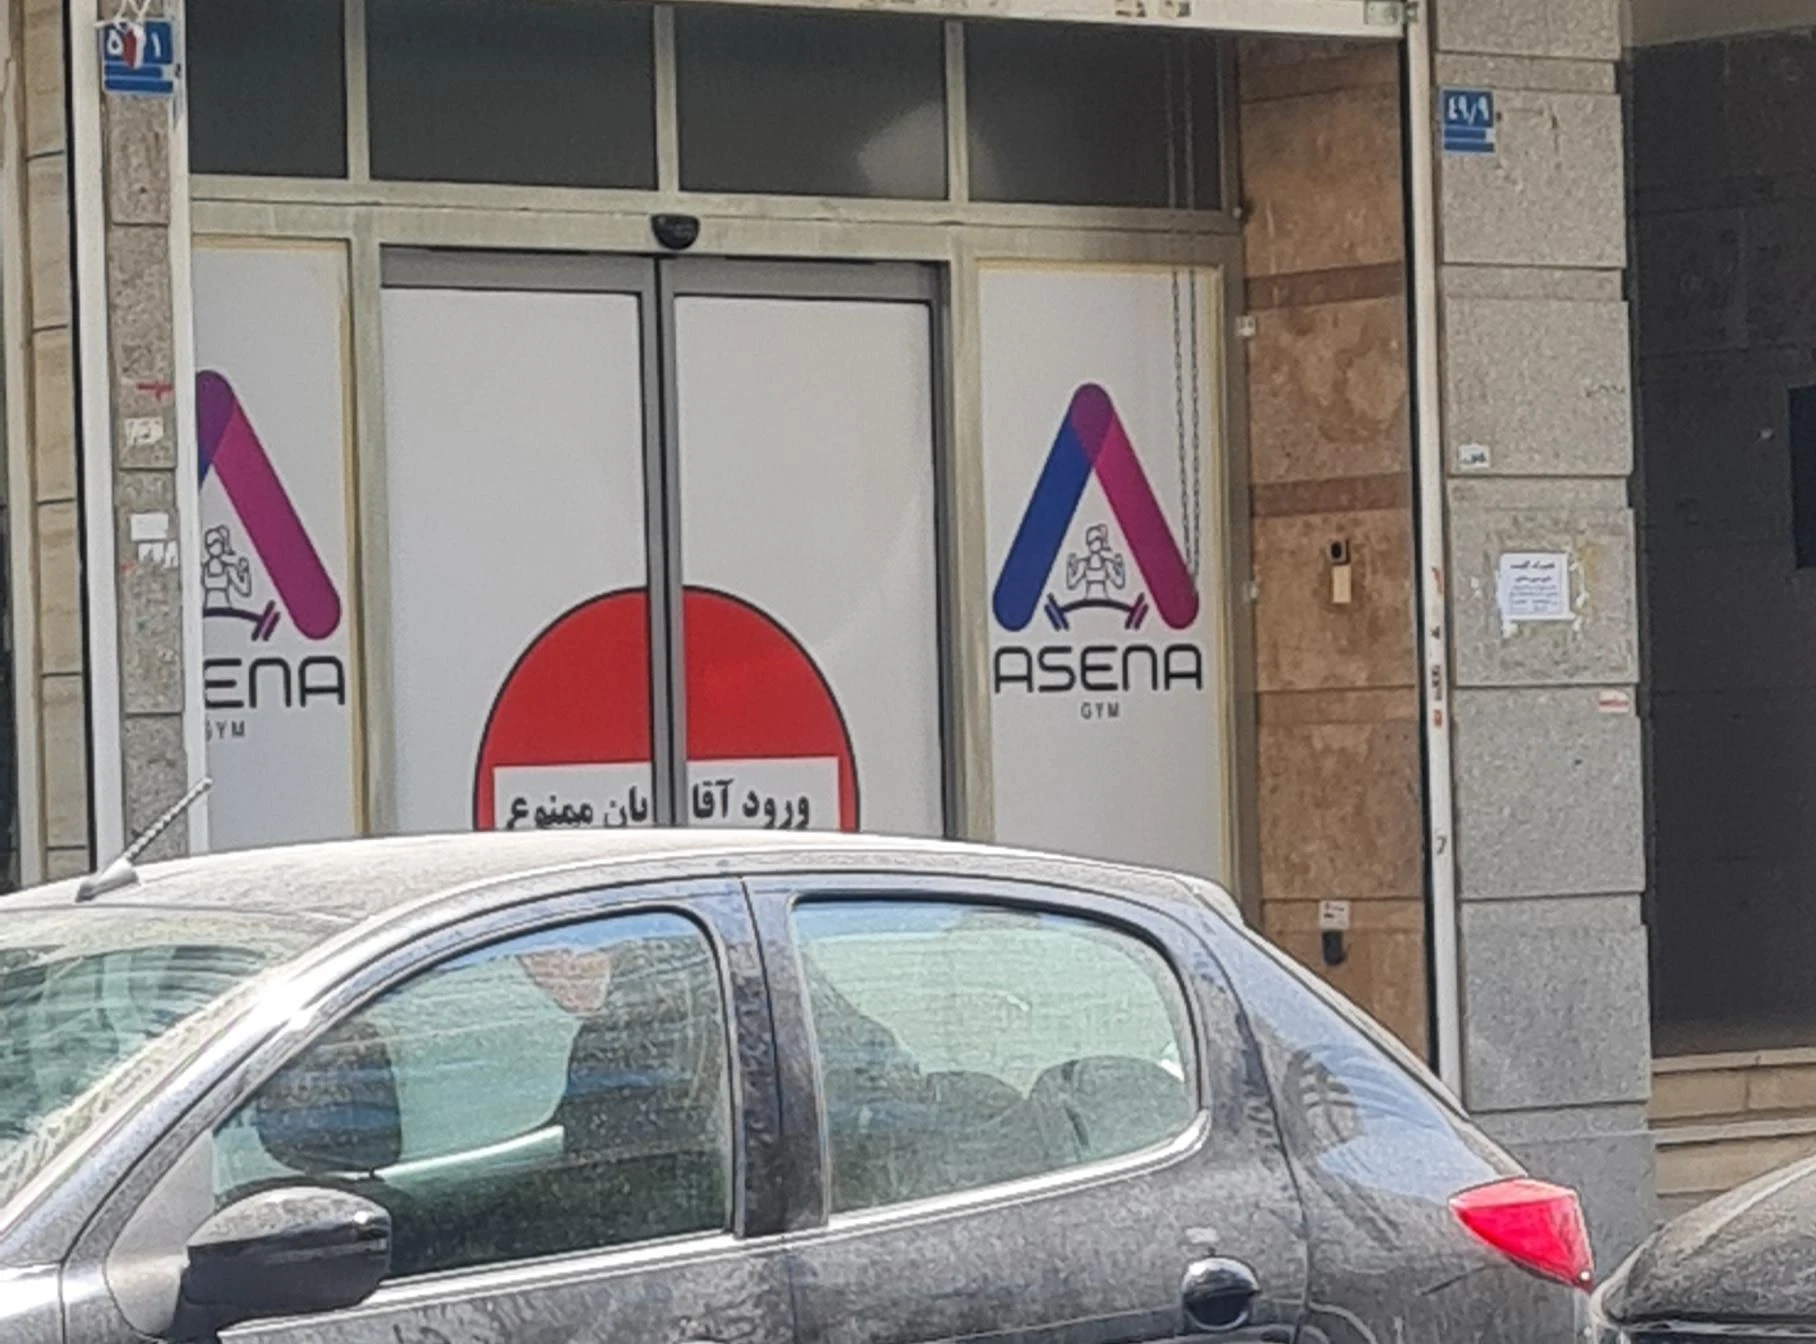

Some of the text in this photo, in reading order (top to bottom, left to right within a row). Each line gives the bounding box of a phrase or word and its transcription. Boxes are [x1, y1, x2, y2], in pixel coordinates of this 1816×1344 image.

[993, 643, 1203, 693] ASENA
[1080, 701, 1120, 719] GYM
[506, 794, 594, 830] ممنوع
[742, 789, 810, 830] ورود
